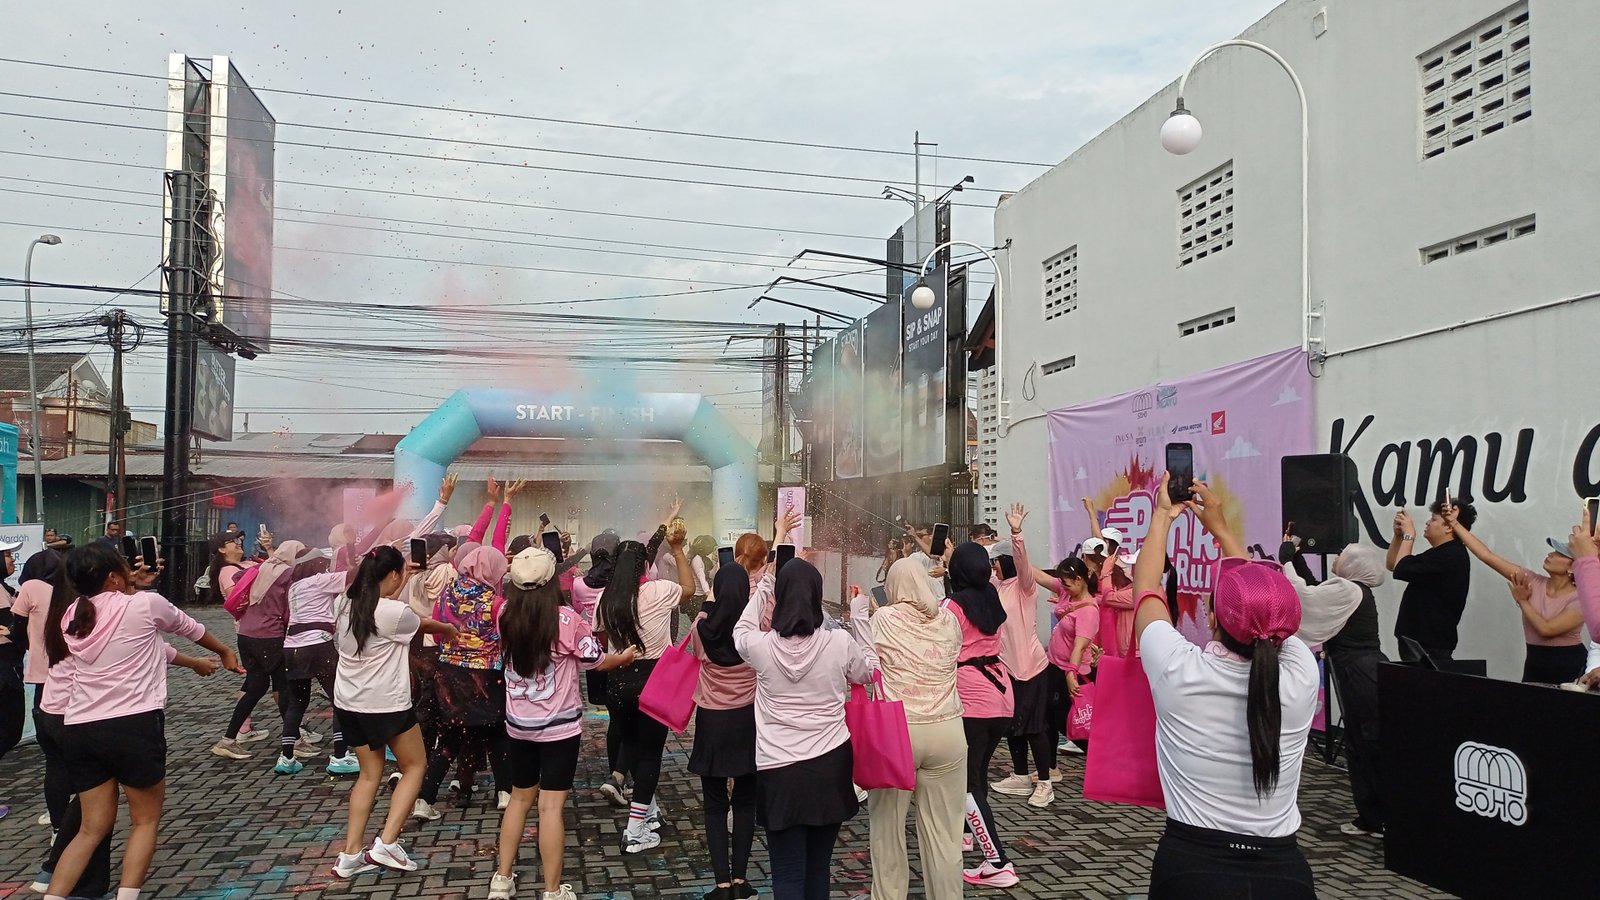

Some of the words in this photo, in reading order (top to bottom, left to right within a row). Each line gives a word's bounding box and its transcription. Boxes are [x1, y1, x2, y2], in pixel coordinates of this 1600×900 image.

[923, 306, 943, 332] SNAP
[515, 404, 575, 421] START
[1330, 415, 1535, 550] Kamu
[966, 808, 997, 858] Reebok
